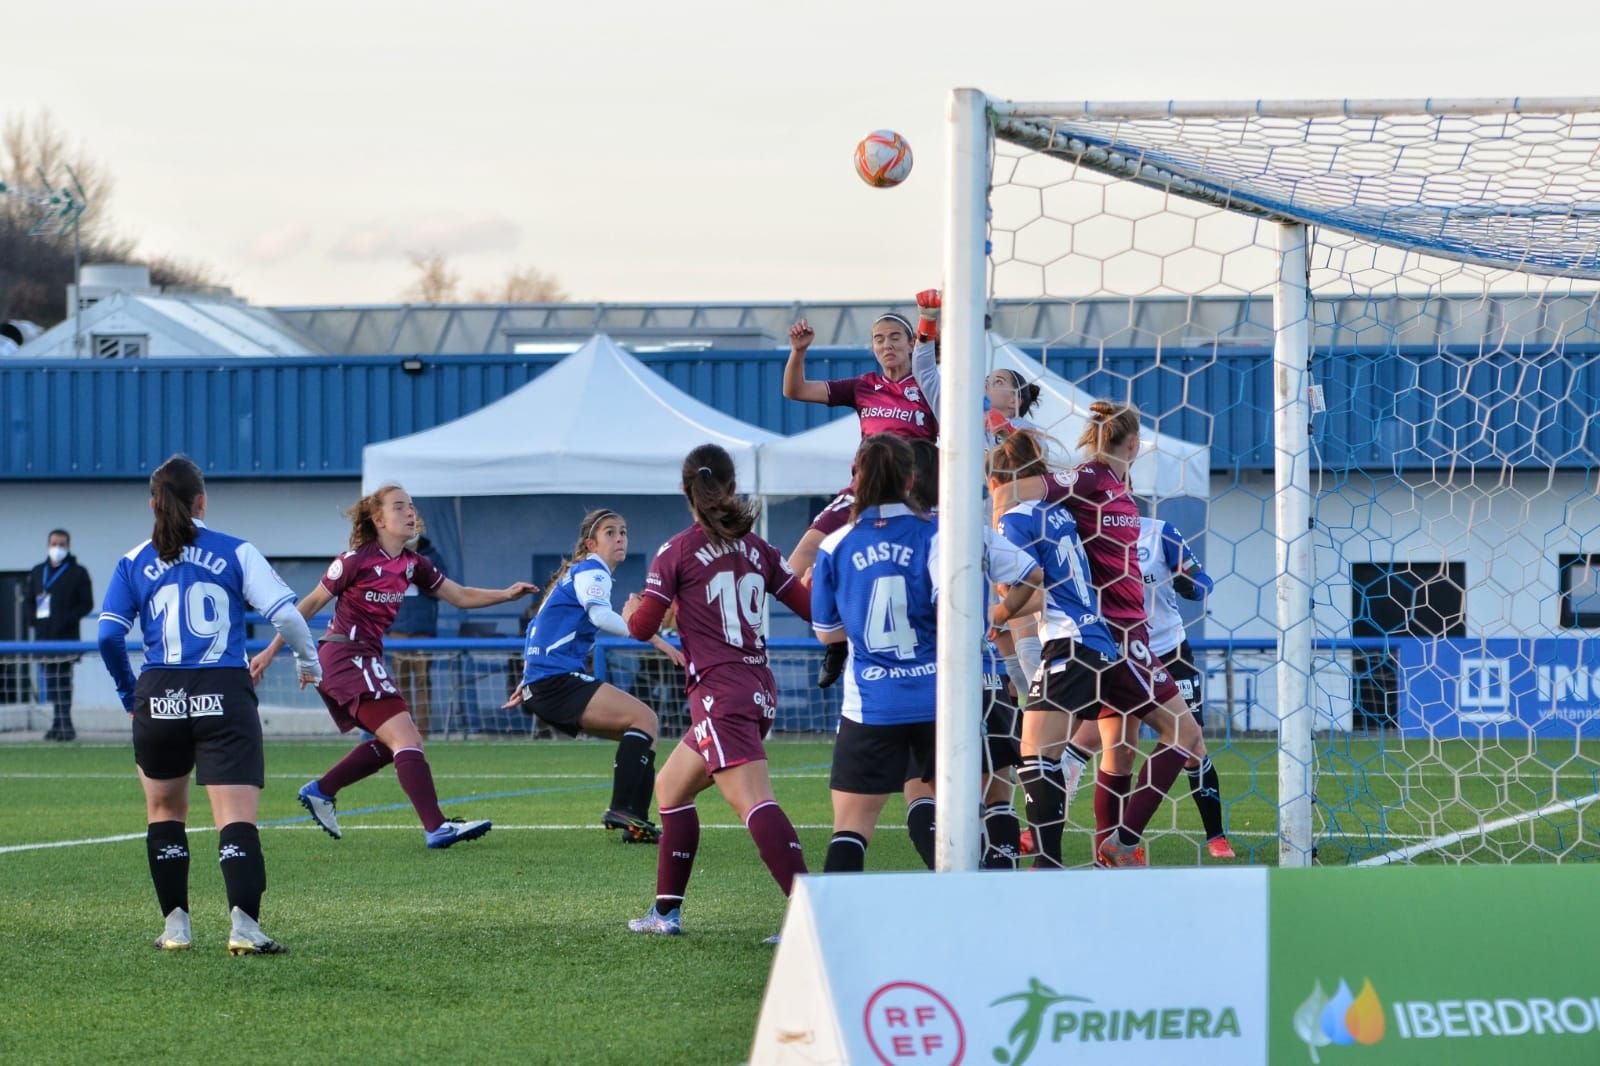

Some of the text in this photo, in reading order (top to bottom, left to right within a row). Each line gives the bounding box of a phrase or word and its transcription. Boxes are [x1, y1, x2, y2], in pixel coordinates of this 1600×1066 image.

[861, 406, 913, 422] euskaltel
[852, 542, 914, 571] GASTE
[149, 580, 232, 664] 19
[706, 570, 766, 650] 19
[864, 575, 919, 660] 4
[371, 656, 388, 680] 6
[1130, 640, 1152, 668] 9
[889, 663, 937, 678] HYUND
[1052, 1007, 1241, 1043] PRIMERA
